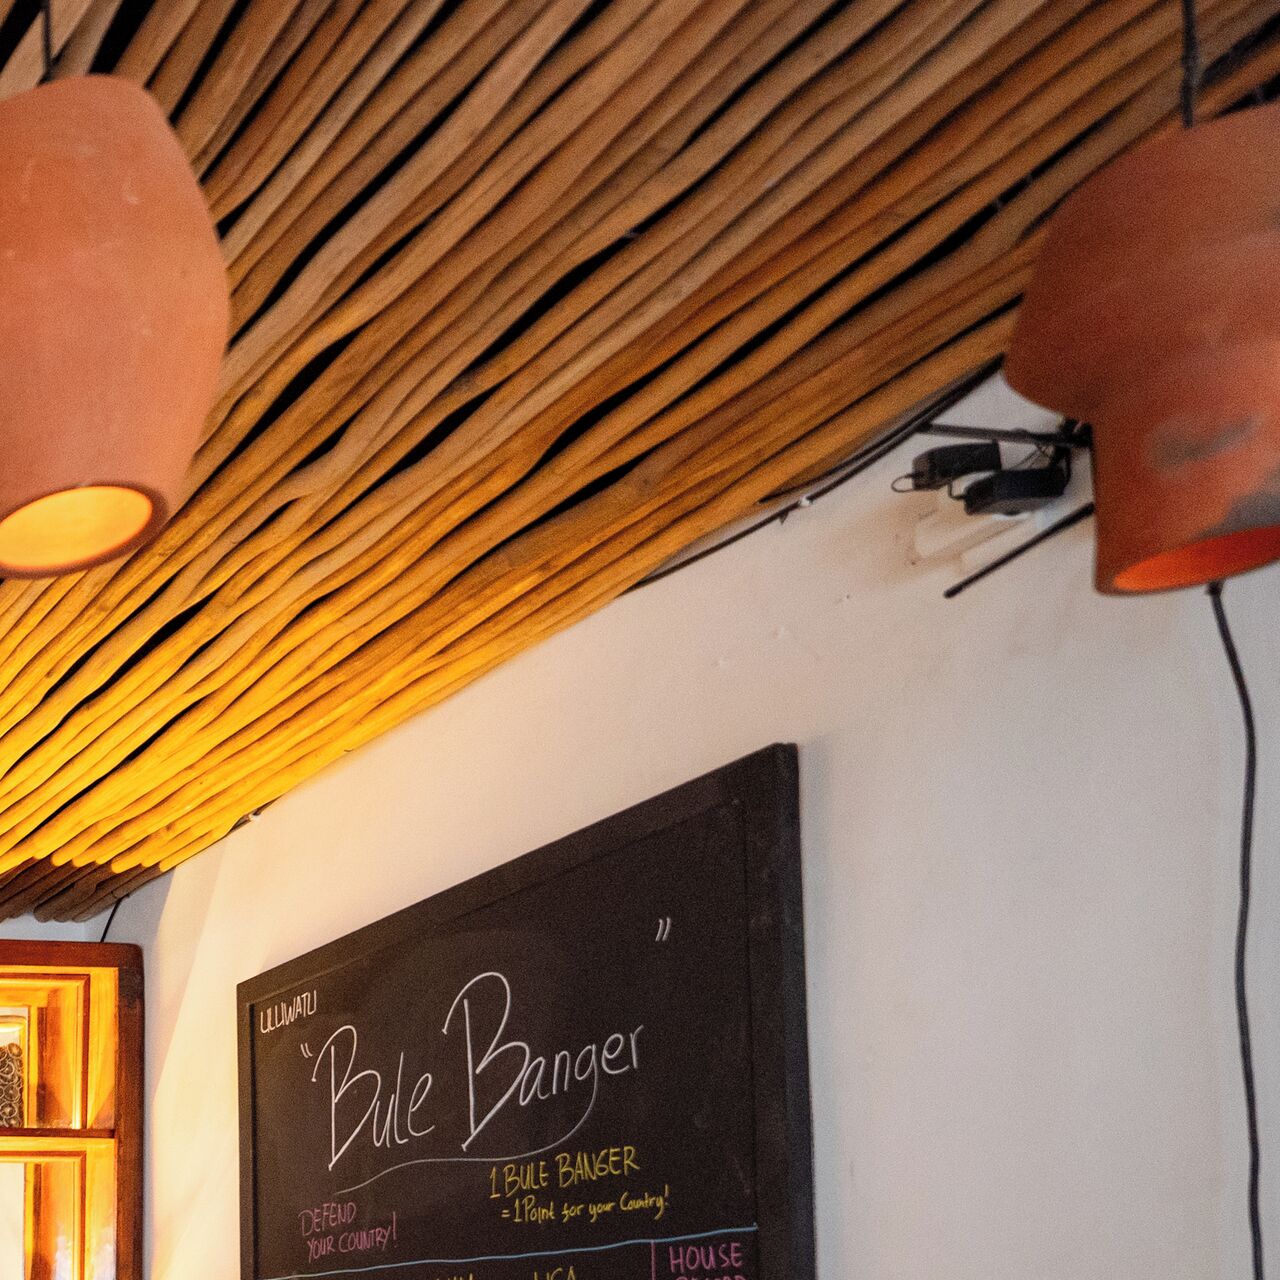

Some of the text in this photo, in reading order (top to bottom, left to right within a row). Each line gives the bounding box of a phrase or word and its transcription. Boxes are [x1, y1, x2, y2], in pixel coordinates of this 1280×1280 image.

[503, 1161, 549, 1198] BULE
[555, 1146, 640, 1188] BANGER
[298, 1202, 357, 1237] DEFEND
[561, 1203, 585, 1223] for
[588, 1202, 615, 1223] your
[619, 1184, 670, 1220] Country!
[306, 1211, 398, 1264] YOUR COUNTRY!
[669, 1242, 743, 1273] HOUSE
